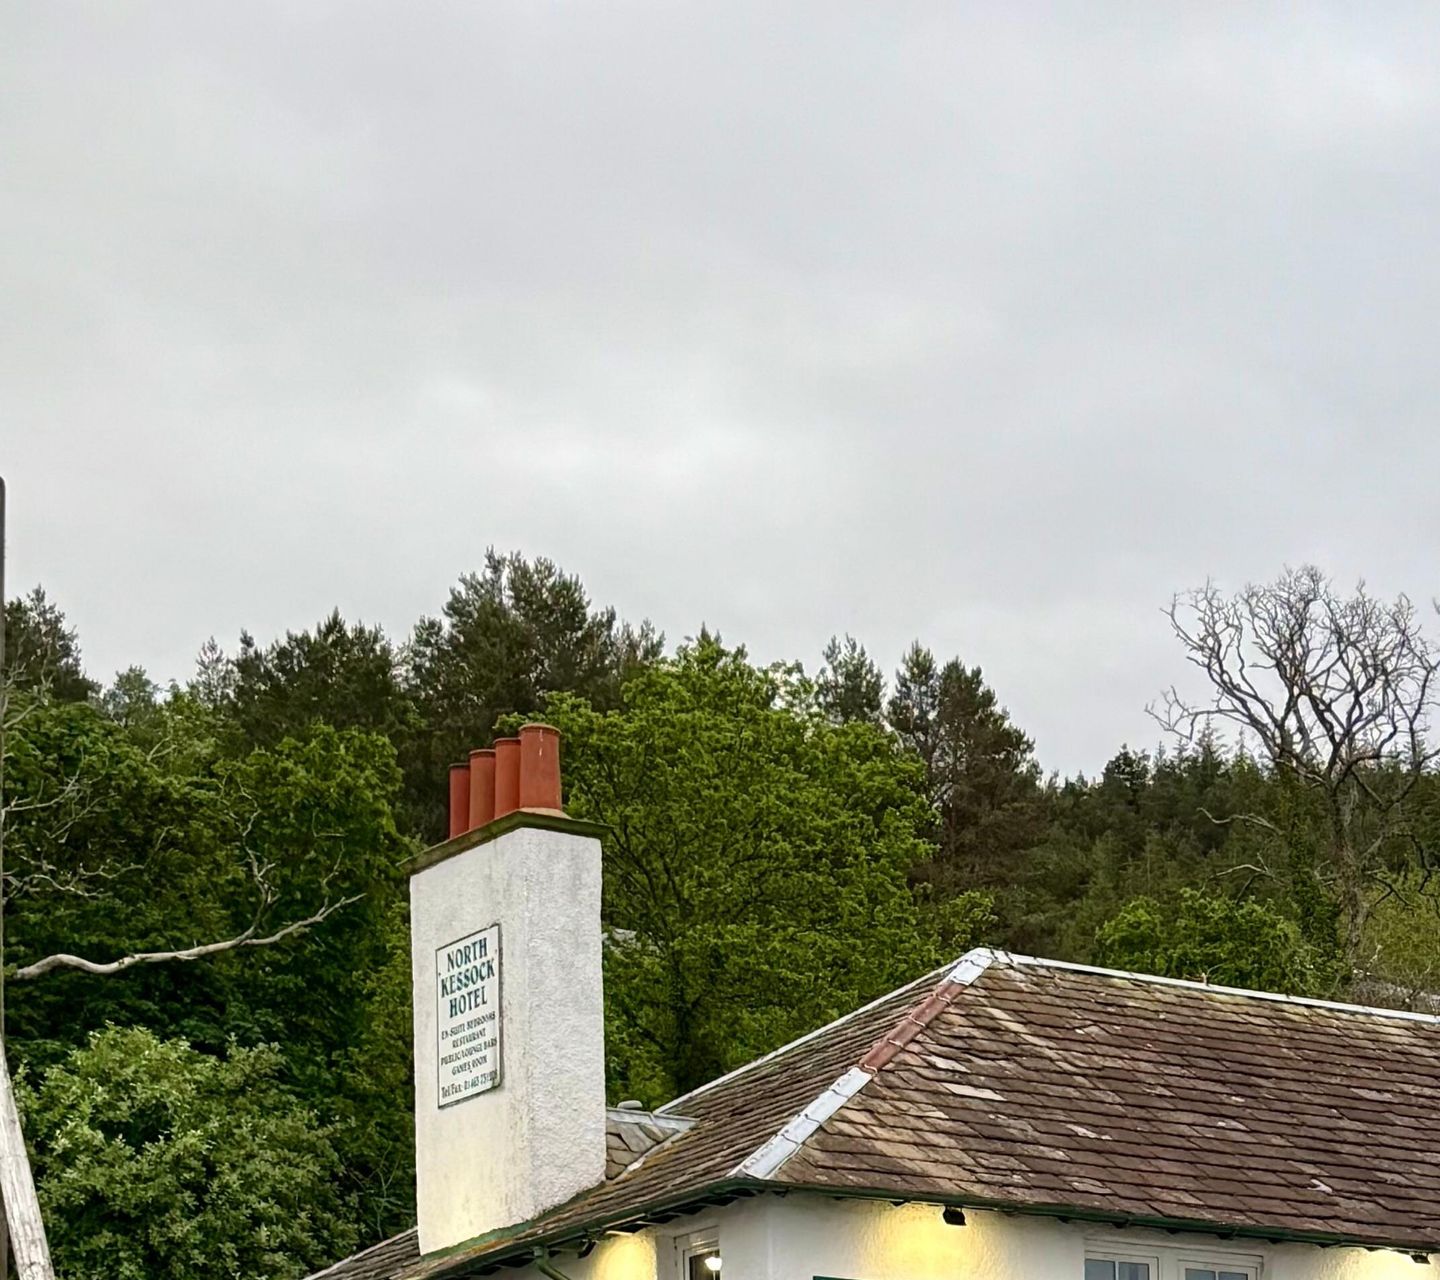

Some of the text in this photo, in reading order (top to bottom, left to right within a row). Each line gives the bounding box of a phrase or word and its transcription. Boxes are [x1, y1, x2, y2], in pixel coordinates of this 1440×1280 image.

[447, 937, 487, 972] NORTH
[441, 958, 495, 998] KESSOCK
[449, 986, 488, 1018] HOTEL
[452, 1028, 486, 1048] RESTAURANT
